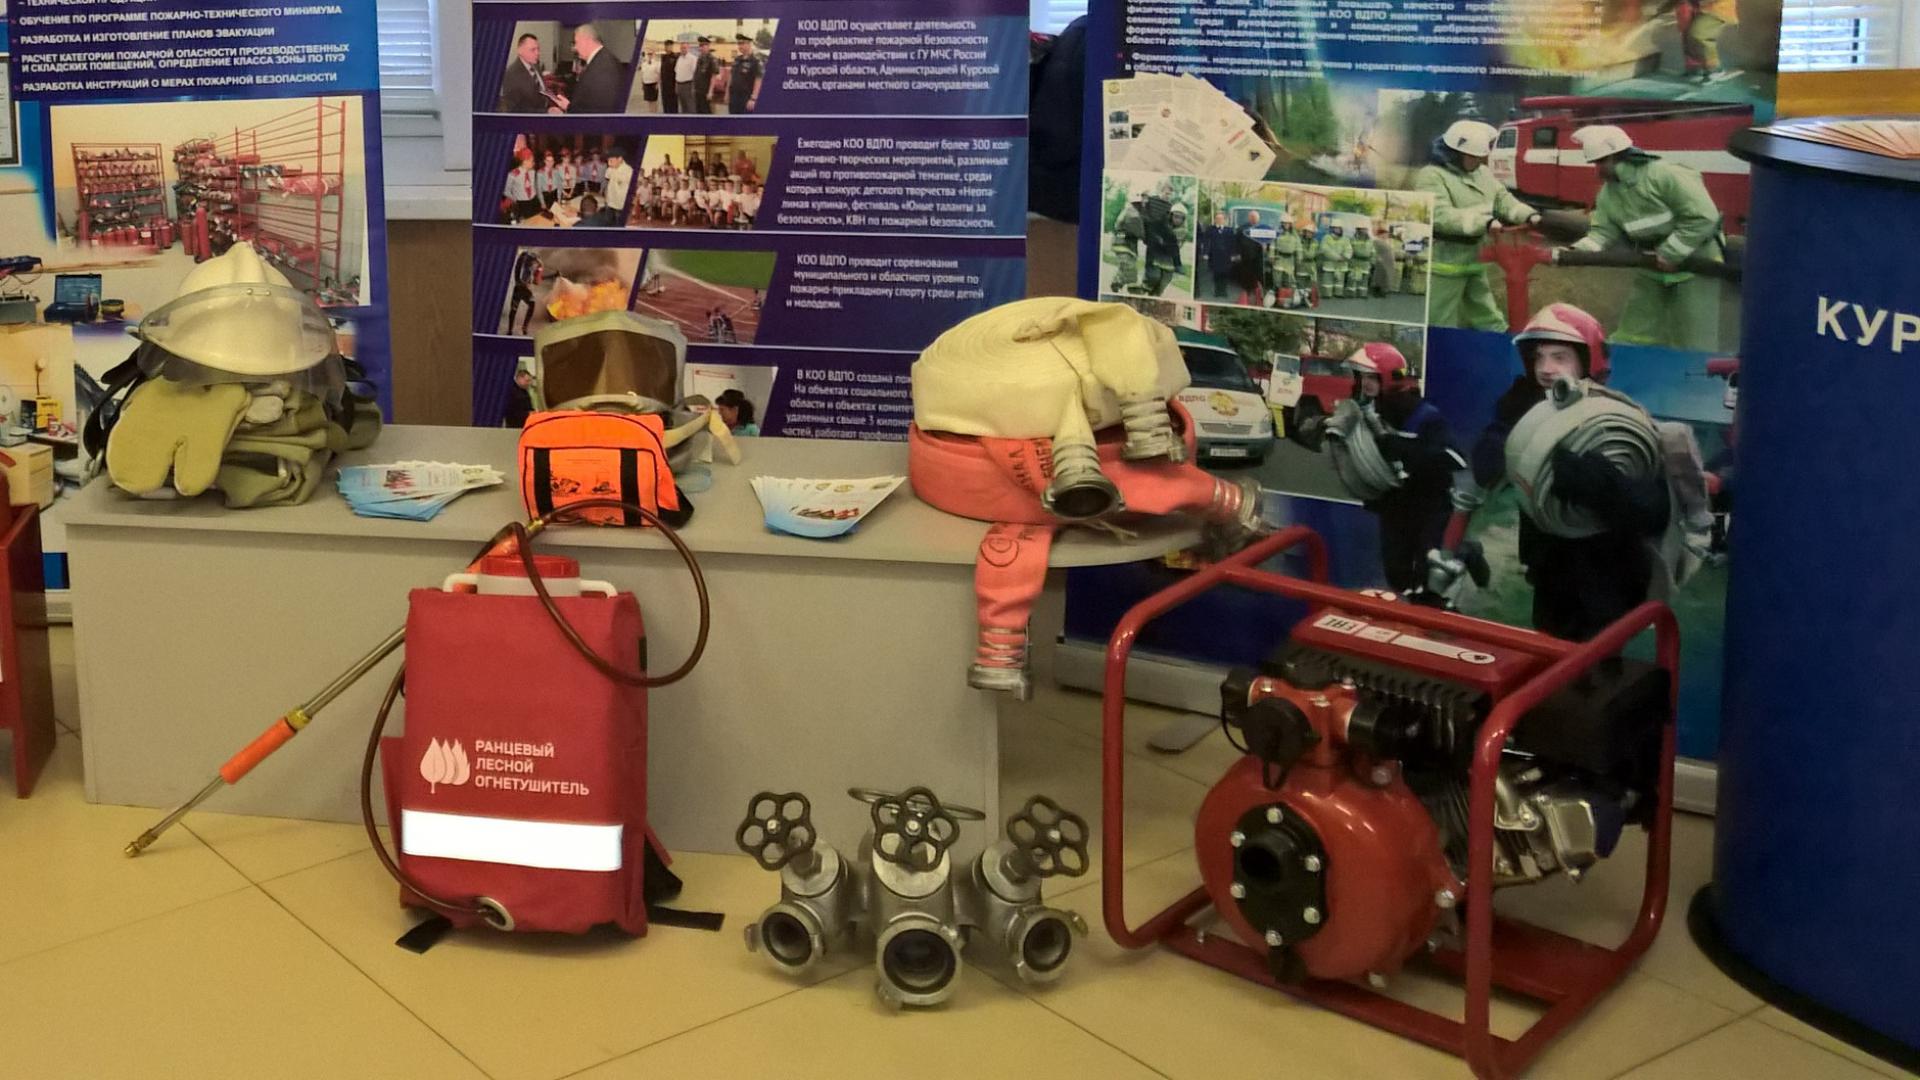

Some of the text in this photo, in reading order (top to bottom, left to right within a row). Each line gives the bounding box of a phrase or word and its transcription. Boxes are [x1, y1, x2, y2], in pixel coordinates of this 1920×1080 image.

[1403, 2, 1454, 10] качество
[20, 6, 342, 26] ОБУЧЕНИЕ ПО ПРОГРАММЕ ПОЖАРНО-ТЕХНИЧЕСКОГО МИНИМУМА
[1127, 6, 1187, 15] физической
[1328, 10, 1352, 19] КОО
[1354, 10, 1388, 20] ВДПО
[798, 20, 976, 32] КОО ВДПО осуществляет деятельность
[1126, 16, 1181, 26] семинаров
[1194, 18, 1224, 26] среди
[1351, 23, 1418, 32] командиров
[20, 28, 275, 45] РАЗРАБОТКА И ИЗГОТОВЛЕНИЕ ПЛАНОВ ЭВАКУАЦИИ
[808, 36, 874, 47] профилактике
[876, 36, 922, 46] пожарной
[924, 35, 988, 46] безопасности
[1126, 36, 1262, 48] области добровольческого
[22, 44, 350, 63] РАСЧЕТ КАТЕГОРИИ ПОЖАРНОЙ ОПАСНОСТИ ПРОИЗВОДСТВЕННЫХ
[791, 50, 986, 61] в тесном взаимодействии с ГУ МЧС России
[31, 62, 88, 72] СКЛАДСКИХ
[158, 58, 231, 69] ОПРЕДЕЛЕНИЕ
[234, 56, 274, 66] КЛАССА
[276, 55, 306, 64] ЗОНЫ
[308, 54, 323, 62] ПО
[326, 54, 346, 62] ПУЭ
[1356, 62, 1488, 75] нормативно-правового
[787, 66, 798, 75] по
[800, 65, 838, 76] Курской
[879, 65, 958, 76] Администрацией
[960, 65, 1000, 76] Курской
[1133, 63, 1174, 72] области
[1175, 65, 1269, 77] добровольческого
[22, 73, 337, 92] РАЗРАБОТКА ИНСТРУКЦИЙ О МЕРАХ ПОЖАРНОЙ БЕЗОПАСНОСТИ
[822, 81, 866, 90] органами
[868, 81, 910, 90] местного
[798, 138, 841, 149] Ежегодно
[843, 138, 864, 149] КОО
[866, 138, 894, 150] ВДПО
[896, 141, 939, 151] проводит
[941, 140, 970, 150] более
[972, 139, 990, 150] 300
[795, 156, 890, 166] лективно-творческих
[958, 157, 1008, 167] различных
[790, 169, 817, 180] акций
[833, 170, 916, 182] противопожарной
[964, 173, 992, 182] среди
[786, 186, 824, 196] которых
[824, 186, 861, 196] конкурс
[863, 187, 904, 196] детского
[906, 188, 956, 198] творчества
[782, 201, 810, 209] лимая
[852, 200, 900, 212] фестиваль
[936, 203, 974, 212] таланты
[976, 204, 986, 212] за
[846, 214, 866, 225] КВН
[868, 217, 880, 225] по
[882, 216, 928, 228] пожарной
[797, 254, 958, 268] КОО ВДПО проводит соревнования
[794, 271, 979, 285] муниципального и областного уровня по
[790, 285, 984, 299] пожарно-прикладному спорту среди детей
[1816, 296, 1920, 353] КУР
[797, 370, 893, 383] В КОО ВДПО создана
[794, 384, 806, 394] На
[808, 385, 848, 396] объектах
[850, 388, 907, 398] социального
[790, 399, 826, 409] области
[836, 402, 876, 412] объектах
[786, 414, 834, 424] удаленных
[836, 416, 866, 425] свыше
[869, 416, 874, 425] 3
[815, 428, 857, 438] работают
[475, 740, 554, 758] РАНЦЕВЫЙ
[475, 758, 534, 774] ЛЕСНОЙ
[475, 775, 590, 796] ОГНЕТУШИТЕЛЬ
